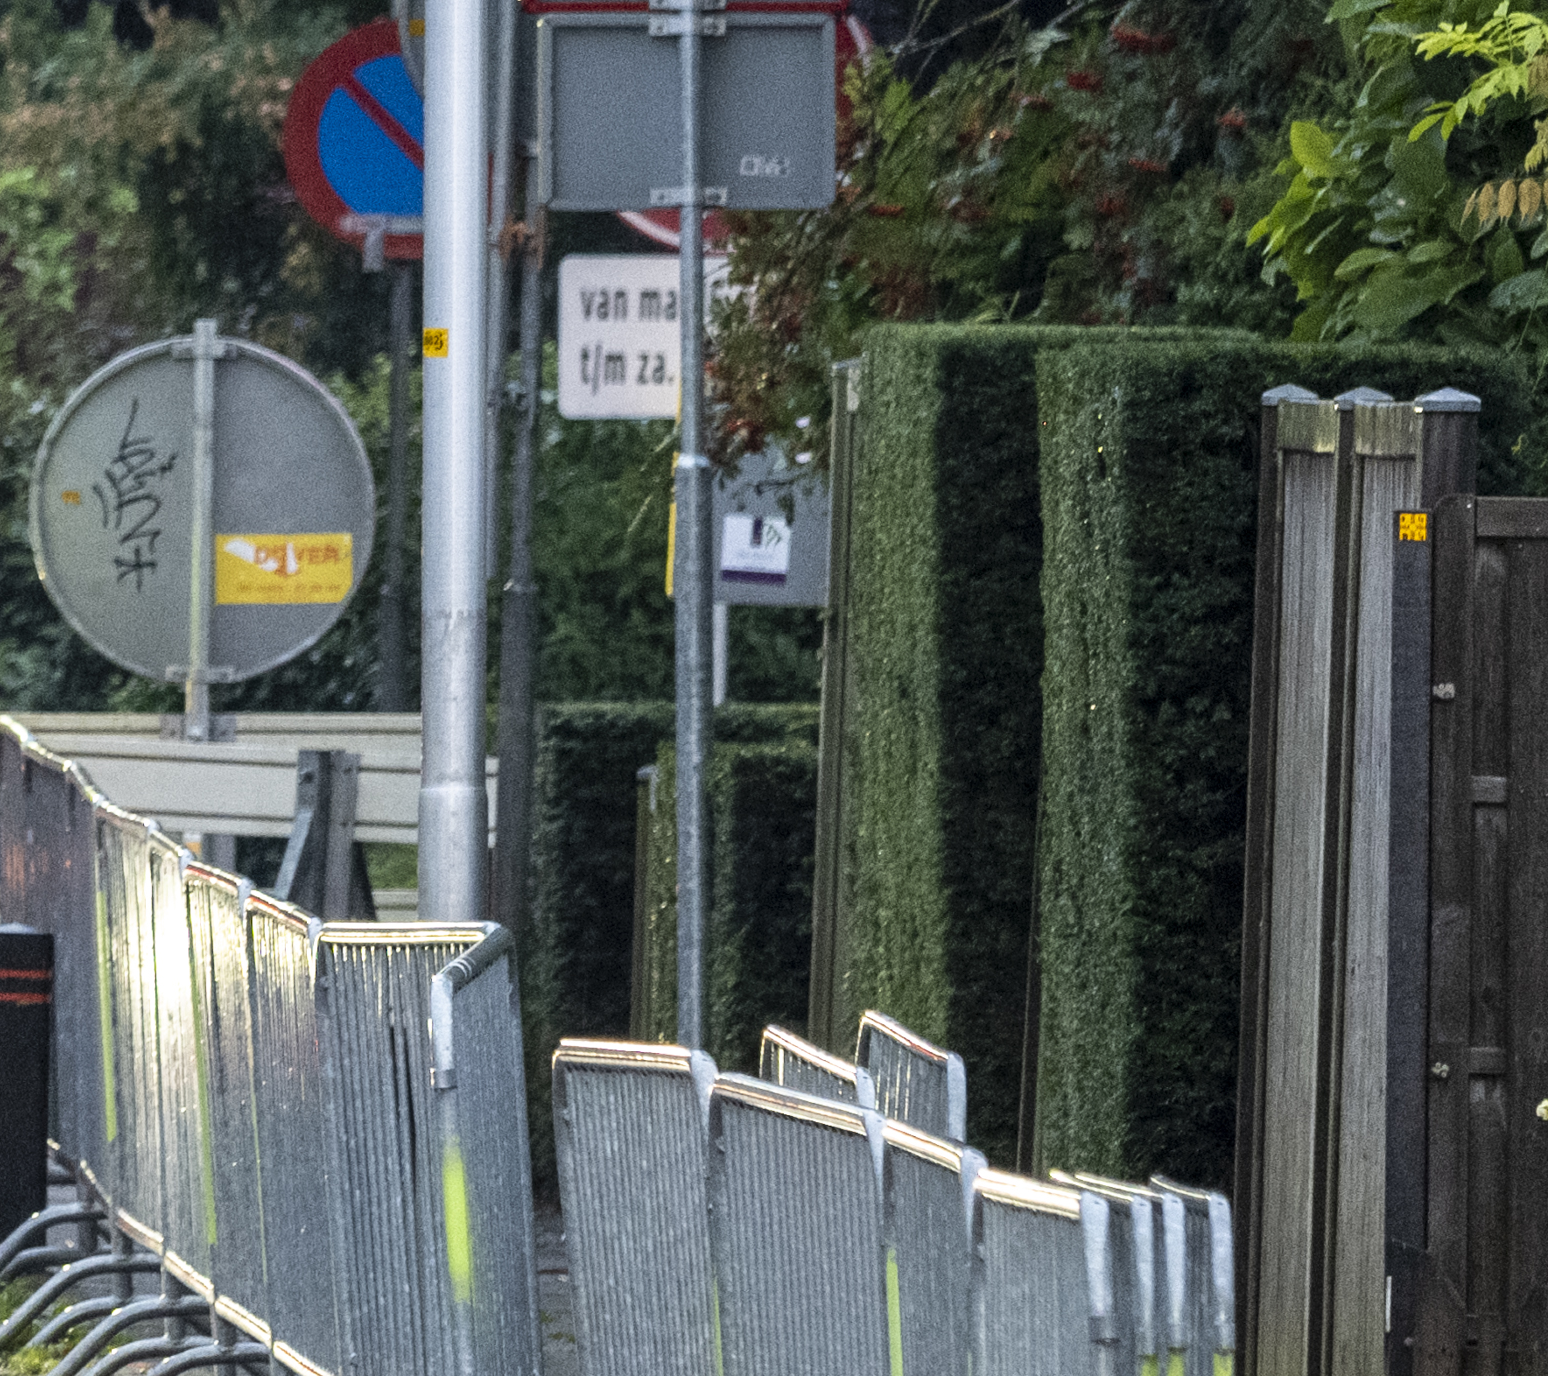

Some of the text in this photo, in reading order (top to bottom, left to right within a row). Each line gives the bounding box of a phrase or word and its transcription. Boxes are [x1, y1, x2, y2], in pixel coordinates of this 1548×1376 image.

[580, 289, 627, 322] van
[580, 343, 674, 397] t/m za.
